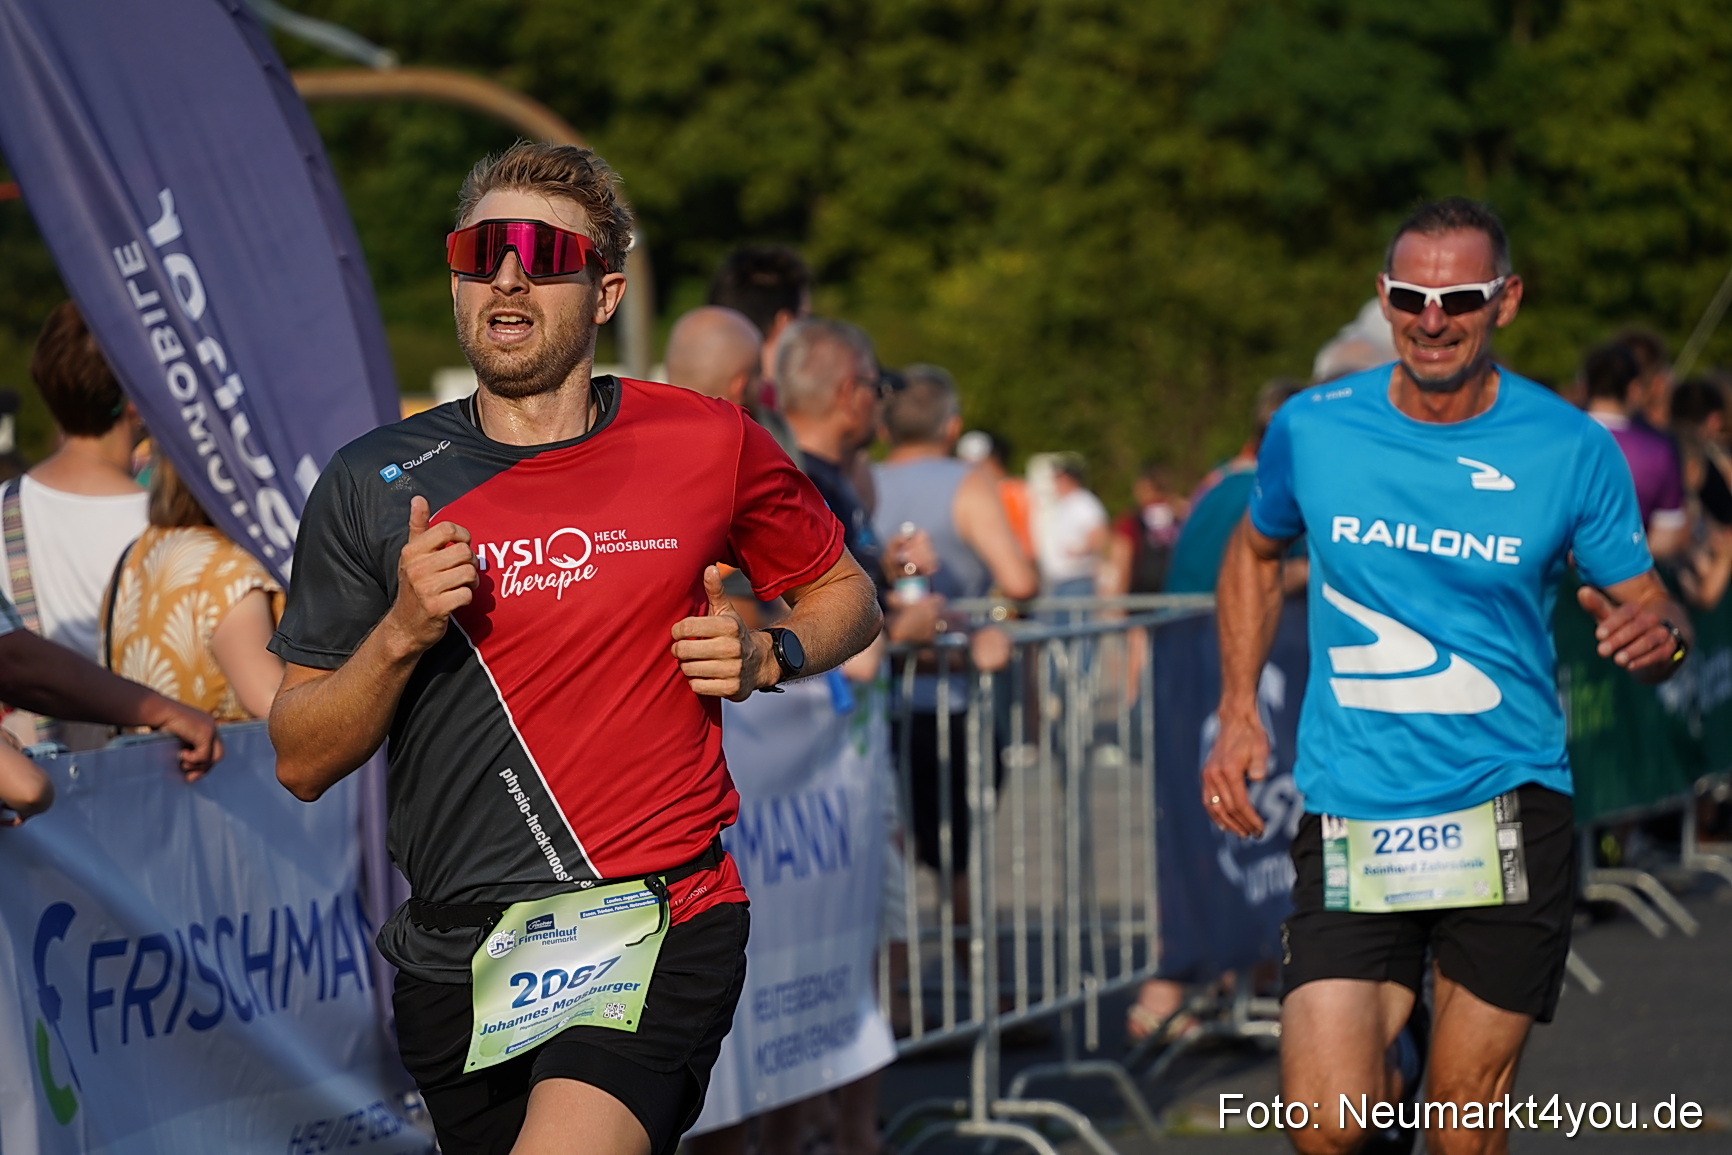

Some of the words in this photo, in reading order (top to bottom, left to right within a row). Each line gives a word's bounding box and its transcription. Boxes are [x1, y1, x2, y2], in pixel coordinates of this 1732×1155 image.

[477, 527, 592, 570] HYSIO
[594, 529, 626, 542] HECK
[595, 538, 679, 555] MOOSBURGER
[1331, 515, 1522, 566] RAILONE
[500, 562, 599, 600] therapie
[1373, 824, 1462, 854] 2266
[518, 925, 578, 946] Firmenlauf
[541, 934, 578, 947] neumarkt
[86, 890, 375, 1054] FRISCHMAN
[510, 955, 621, 1010] 2067
[480, 1006, 549, 1037] Johannes
[552, 981, 642, 1013] Moosburger
